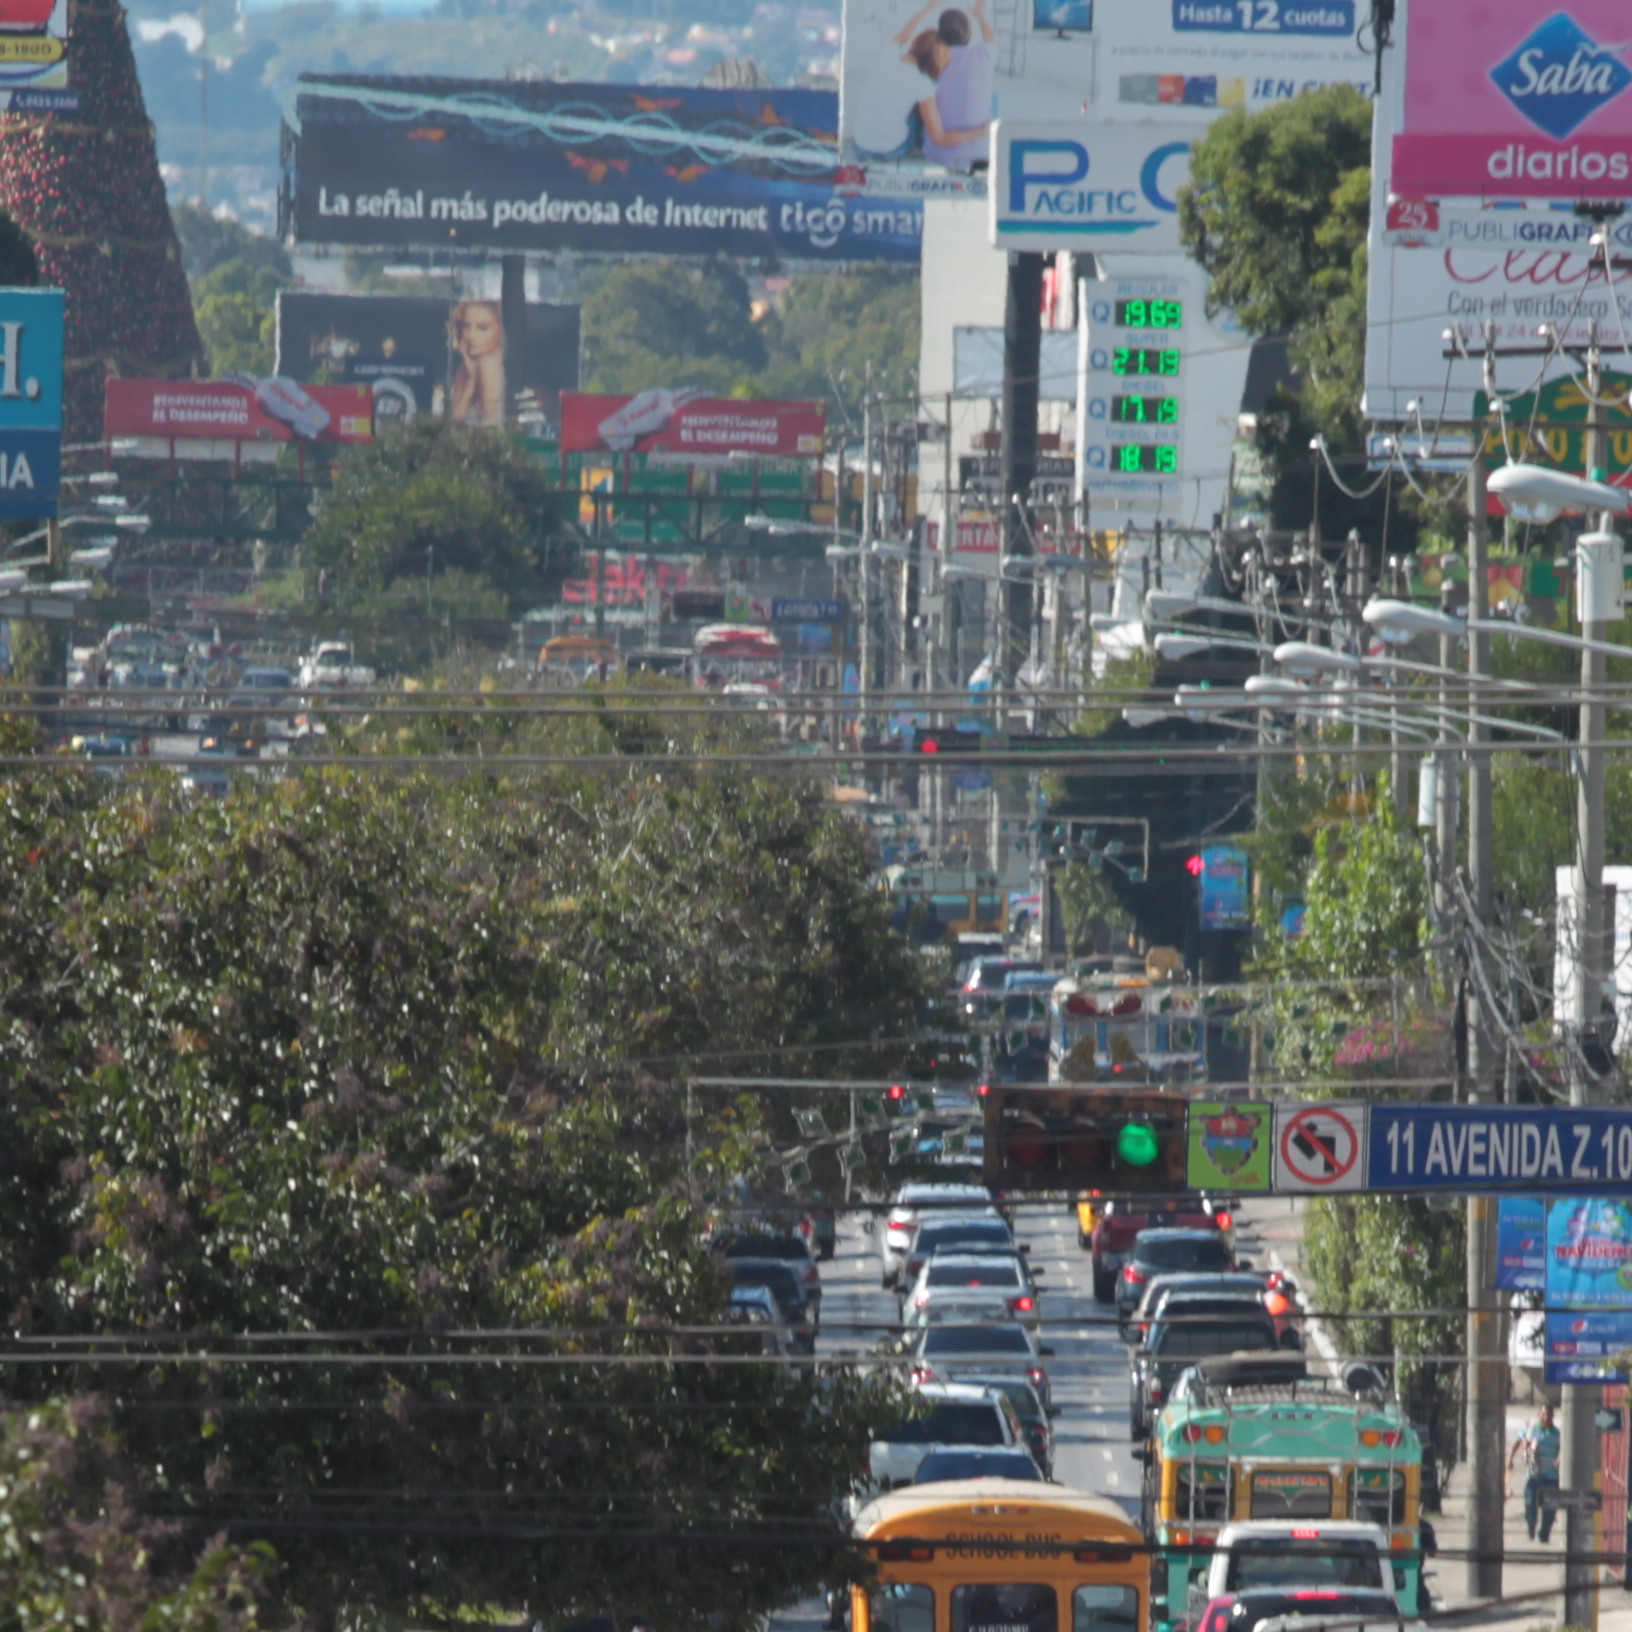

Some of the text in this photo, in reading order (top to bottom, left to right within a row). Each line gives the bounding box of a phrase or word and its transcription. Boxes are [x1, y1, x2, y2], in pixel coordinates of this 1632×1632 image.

[1237, 0, 1280, 31] 12
[1510, 48, 1613, 96] Saba
[1487, 144, 1630, 181] diarios
[318, 187, 350, 218] La
[355, 188, 424, 221] señal
[430, 192, 488, 222] más
[493, 193, 621, 228] poderosa
[625, 195, 659, 227] de
[664, 196, 768, 231] Internet
[1447, 292, 1486, 317] Con
[1491, 290, 1506, 317] el
[1512, 291, 1609, 319] verdadero
[1386, 1120, 1415, 1176] 11
[1424, 1120, 1564, 1177] AVENIDA
